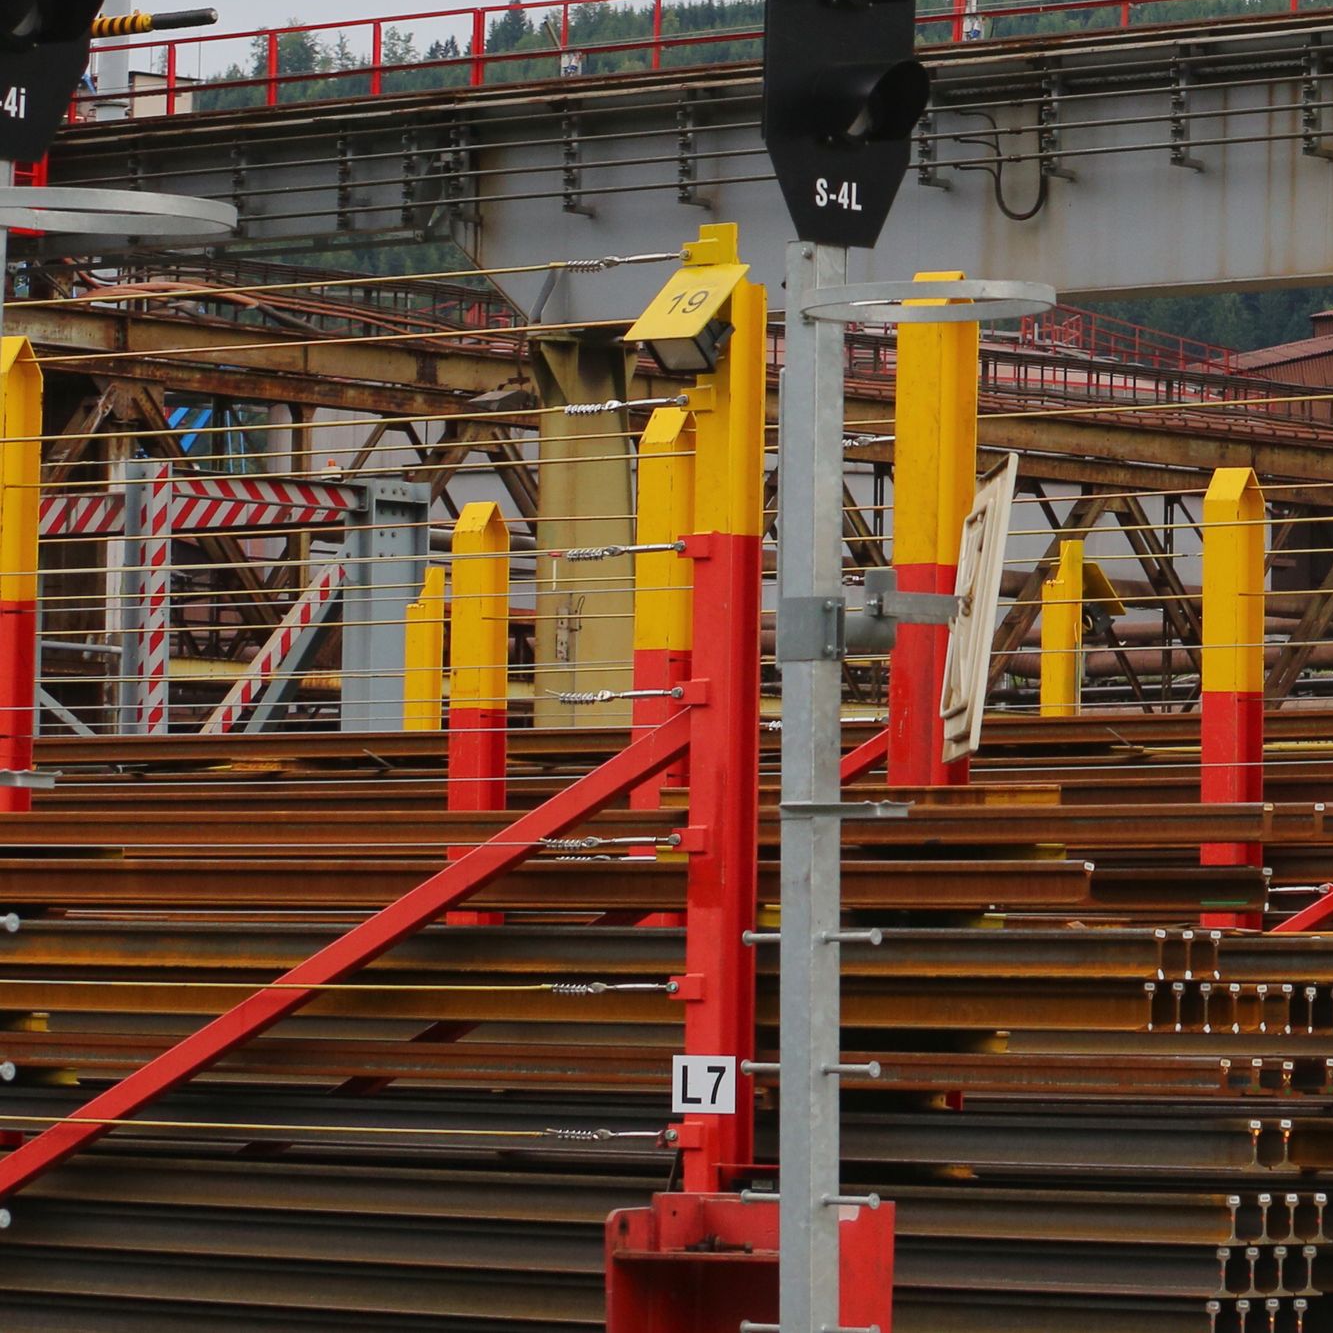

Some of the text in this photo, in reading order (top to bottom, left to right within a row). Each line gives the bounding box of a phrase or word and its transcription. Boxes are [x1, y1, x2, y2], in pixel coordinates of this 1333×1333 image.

[815, 177, 862, 211] S-4L
[667, 290, 709, 315] 19
[681, 1065, 727, 1105] L7
